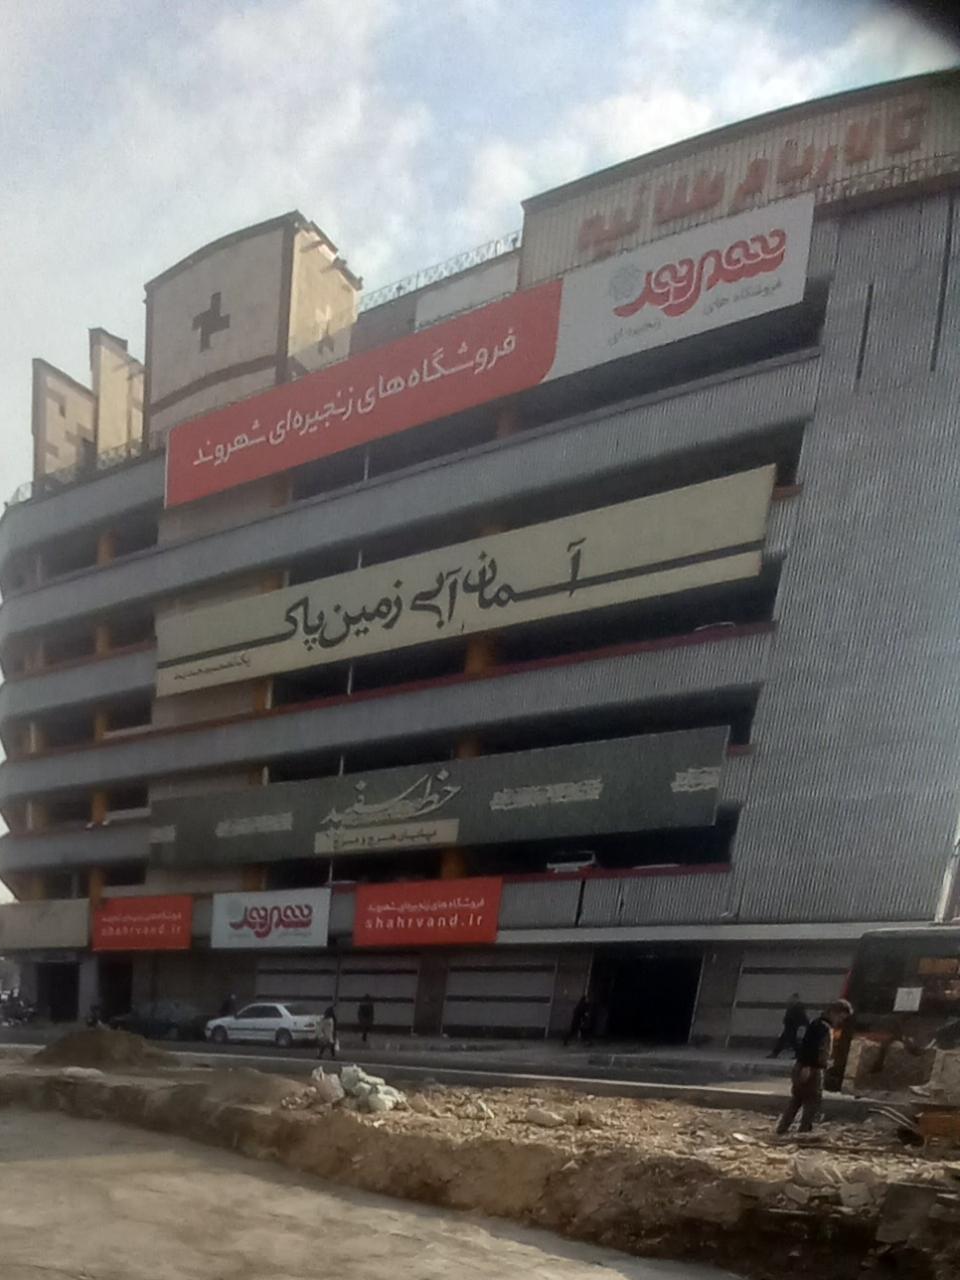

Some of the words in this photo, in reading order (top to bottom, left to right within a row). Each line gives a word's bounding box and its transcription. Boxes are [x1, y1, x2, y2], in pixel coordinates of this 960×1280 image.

[193, 419, 267, 467] شهروند
[410, 567, 463, 630] آبی
[462, 537, 588, 611] آسمان
[318, 578, 403, 649] زمین
[365, 913, 483, 929] shahrvand.ir
